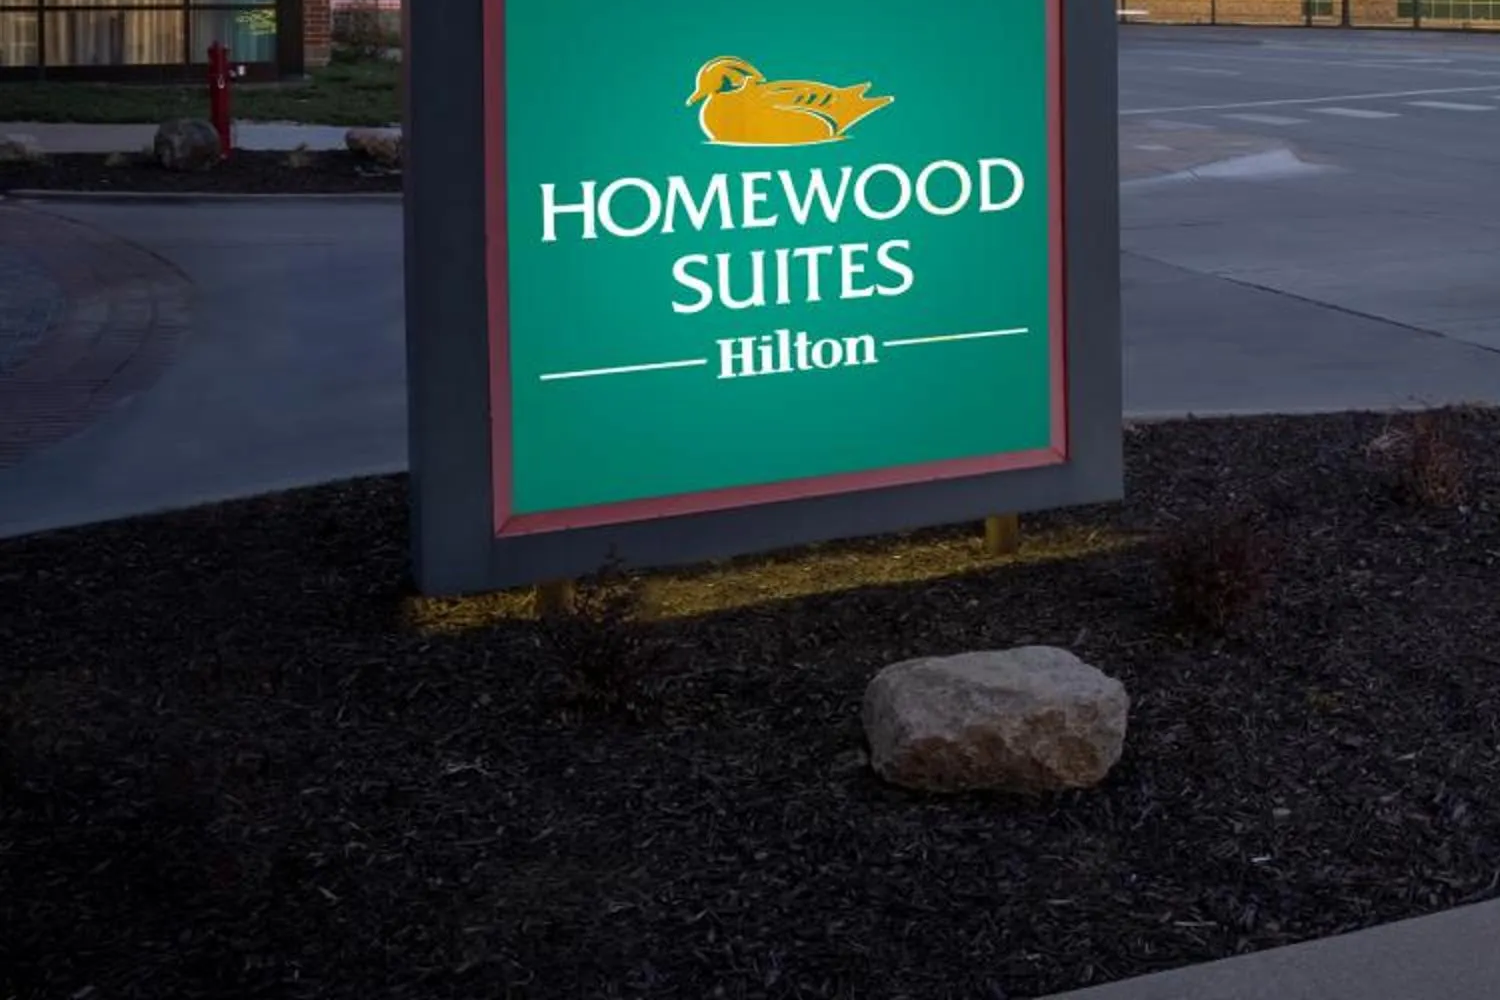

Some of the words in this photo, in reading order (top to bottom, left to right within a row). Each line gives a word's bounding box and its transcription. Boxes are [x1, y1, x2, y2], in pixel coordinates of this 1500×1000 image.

[540, 157, 1025, 243] HOMEWOOD
[670, 238, 915, 314] SUITES
[715, 328, 879, 380] Hilton
